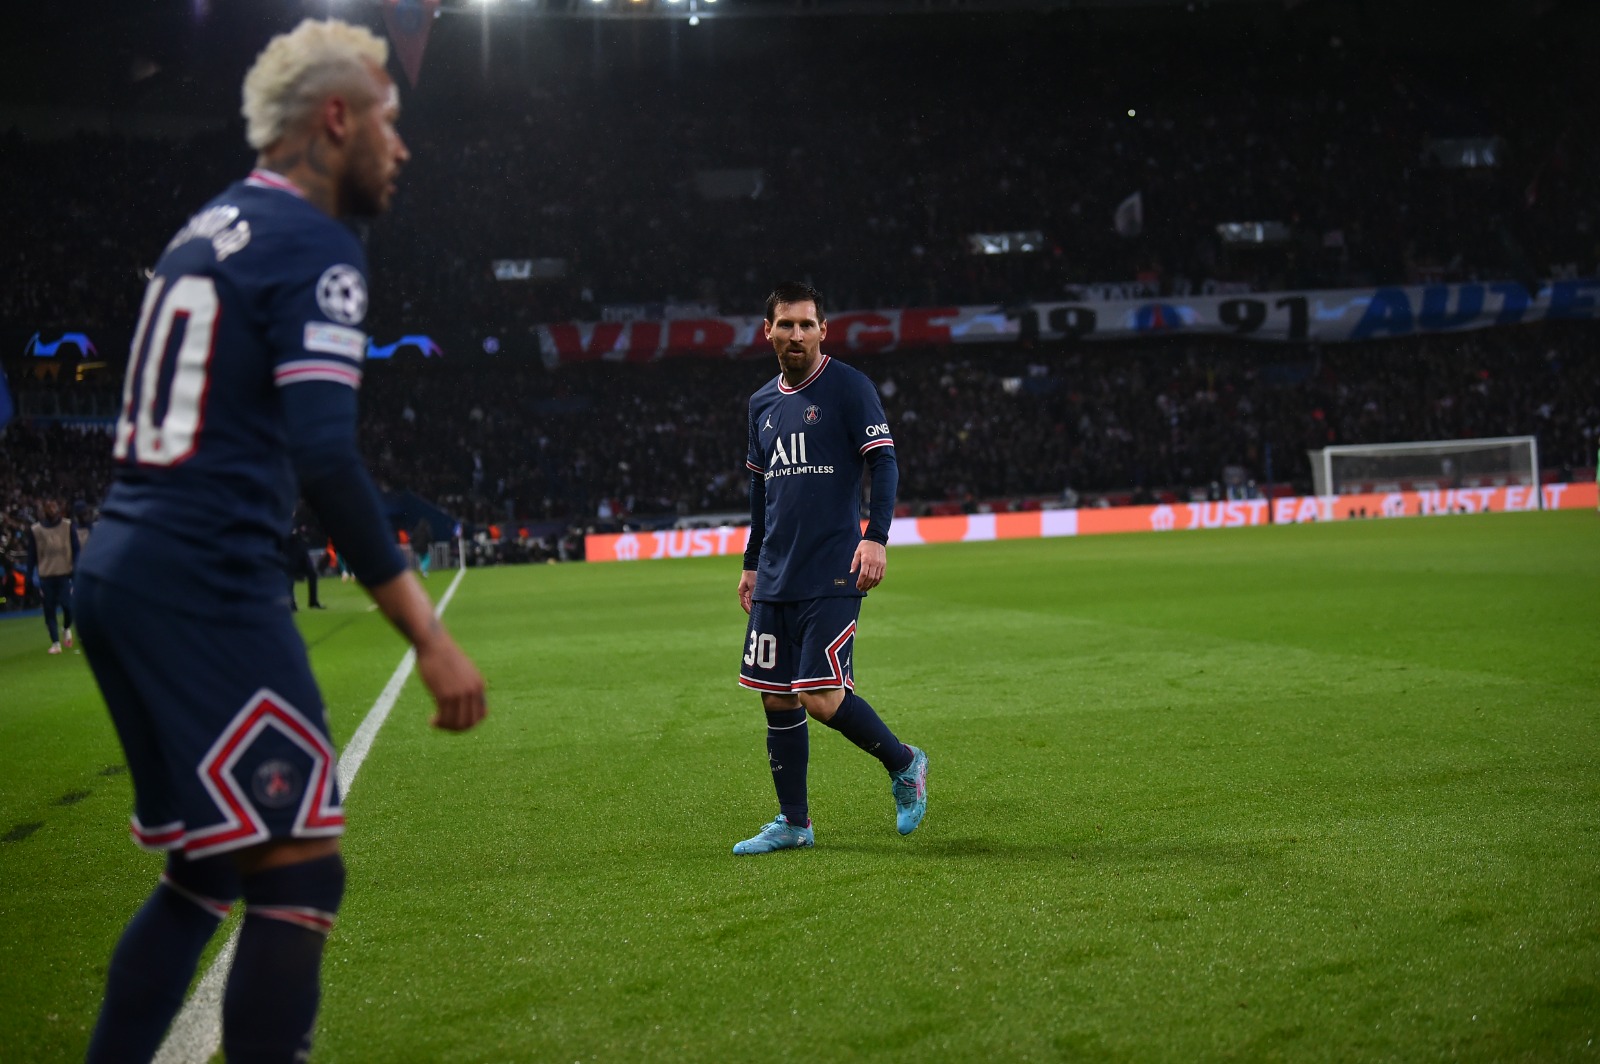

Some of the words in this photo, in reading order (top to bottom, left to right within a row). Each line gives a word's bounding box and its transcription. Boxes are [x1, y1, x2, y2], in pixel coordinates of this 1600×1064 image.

[1218, 298, 1309, 341] 91
[113, 273, 222, 468] 10
[865, 423, 890, 437] QNB
[775, 467, 792, 477] LIVE
[792, 465, 835, 475] LIMITLESS
[1186, 499, 1270, 530] JUST
[1273, 494, 1341, 526] EAT
[1417, 485, 1497, 517] JUST
[651, 526, 735, 560] JUST
[743, 629, 778, 669] 30
